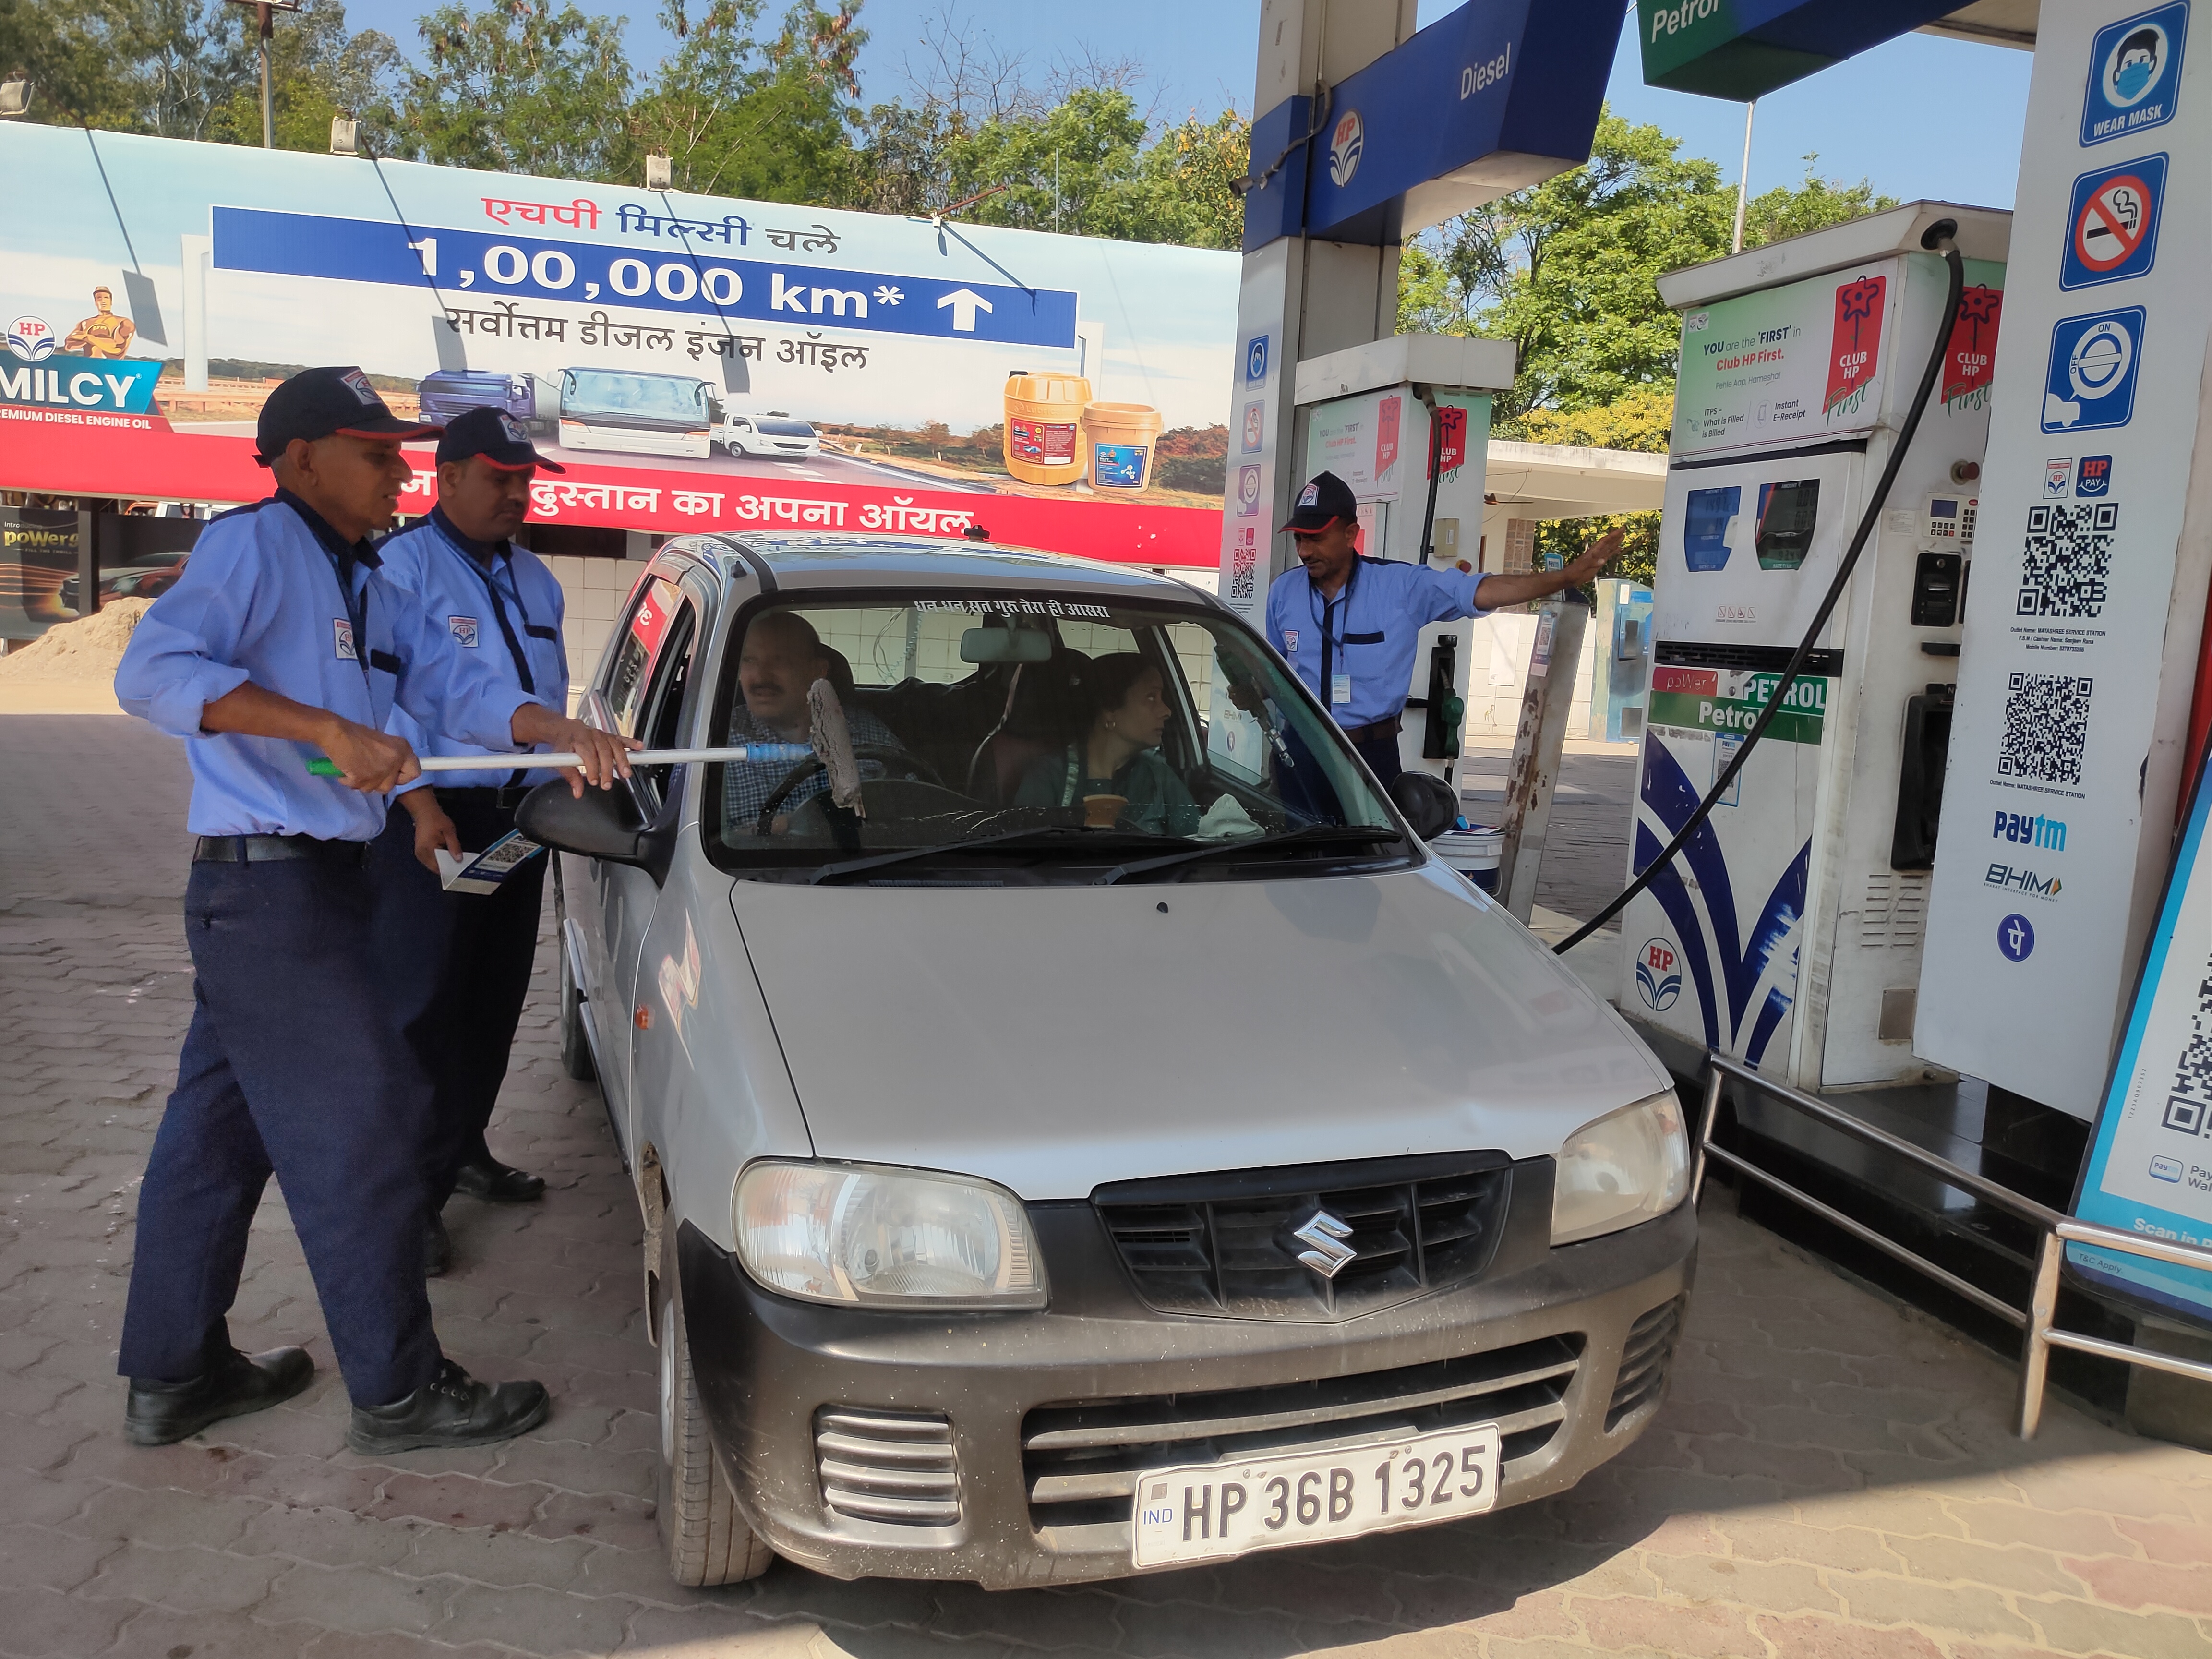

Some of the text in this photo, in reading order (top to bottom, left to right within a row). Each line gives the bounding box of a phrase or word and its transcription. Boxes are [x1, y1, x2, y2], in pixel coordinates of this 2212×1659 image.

[1460, 42, 1511, 101] Diesel
[2094, 104, 2163, 137] WEAR MASK
[1336, 118, 1356, 147] HP
[481, 198, 841, 254] एचपी मिल्सी चले
[407, 239, 743, 306] 1,00,000
[19, 322, 45, 336] HP
[2098, 323, 2111, 332] ON
[445, 301, 869, 373] सर्वोत्तम डीजल इंजन ऑइल
[1704, 341, 1724, 355] YOU
[1726, 342, 1739, 351] are
[1742, 337, 1755, 348] the
[1793, 327, 1801, 338] in
[1717, 348, 1784, 371] Club HP First.
[1839, 351, 1867, 367] CLUB
[1957, 353, 1987, 366] CLUB
[1843, 367, 1860, 379] HP
[1962, 365, 1979, 376] HP
[1716, 381, 1731, 389] Pehle
[1748, 372, 1780, 385] Hamesha!
[1775, 399, 1799, 410] Instant
[1826, 376, 1874, 427] First
[1944, 379, 1993, 418] First
[0, 409, 152, 429] EMIUM DIESEL ENGINE OIL
[1026, 406, 1074, 416] Lubrica
[1705, 408, 1717, 416] ITPS
[1773, 410, 1806, 422] E-Receipt
[1704, 418, 1720, 427] What
[1728, 414, 1744, 423] Filled
[1320, 429, 1329, 437] YOU
[1708, 428, 1725, 437] Billed
[1381, 443, 1393, 452] CLUB
[1439, 464, 1463, 483] irst
[2083, 460, 2107, 477] HP
[2085, 479, 2101, 487] PAY
[530, 480, 974, 533] दुस्तान का अपना ऑयल
[914, 601, 939, 613] धन
[941, 601, 966, 612] धन
[1020, 598, 1046, 613] तेरा
[1046, 600, 1065, 617] ही
[1065, 603, 1111, 618] आसरा
[1699, 702, 1760, 730] Petro
[2017, 783, 2044, 792] MATASHREE
[1985, 863, 2054, 895] BHIM
[2002, 887, 2027, 896] INTERFACE
[1648, 946, 1673, 972] HP
[2134, 1218, 2177, 1240] Scan
[2181, 1231, 2197, 1245] in
[2079, 1253, 2096, 1263] T&C
[1183, 1445, 1486, 1542] HP 36B 1325
[1143, 1508, 1173, 1525] IND
